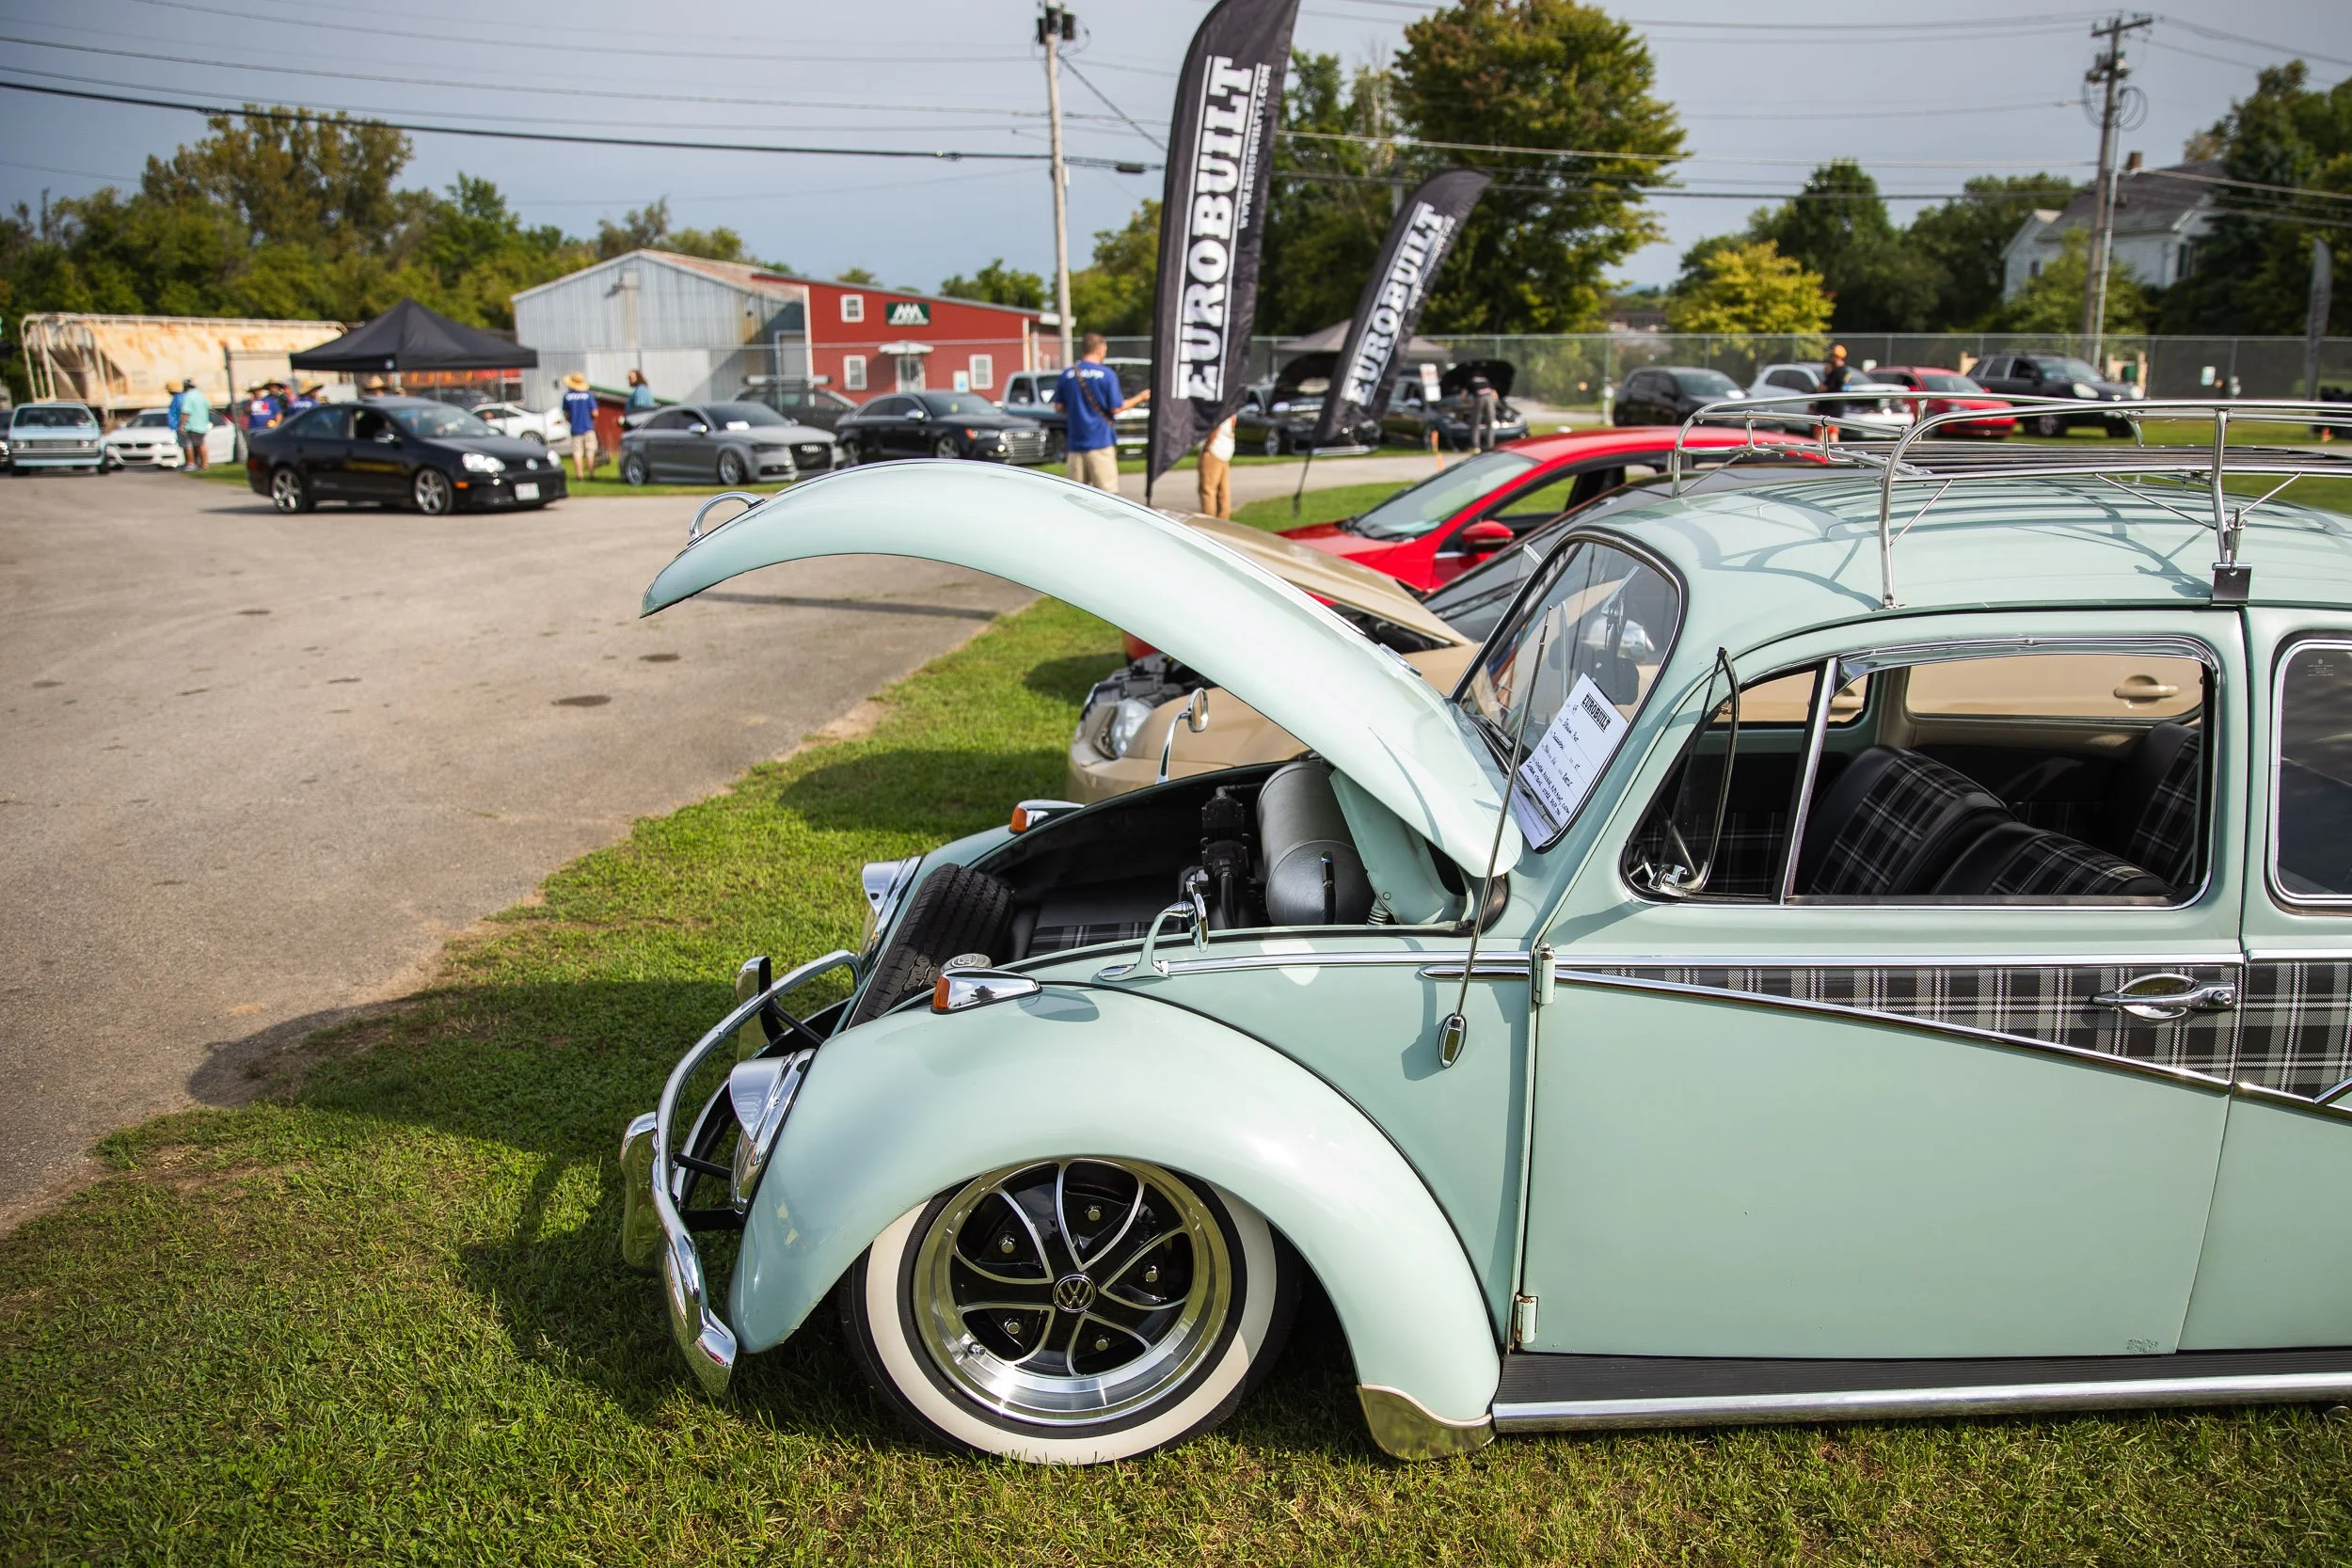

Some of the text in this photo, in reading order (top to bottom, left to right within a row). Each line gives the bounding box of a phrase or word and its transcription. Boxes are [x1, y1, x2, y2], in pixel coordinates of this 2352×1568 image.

[1178, 56, 1254, 403] EUROBUILT
[1345, 202, 1447, 406] EUROBUILT
[1581, 694, 1612, 732] EUROBUILT
